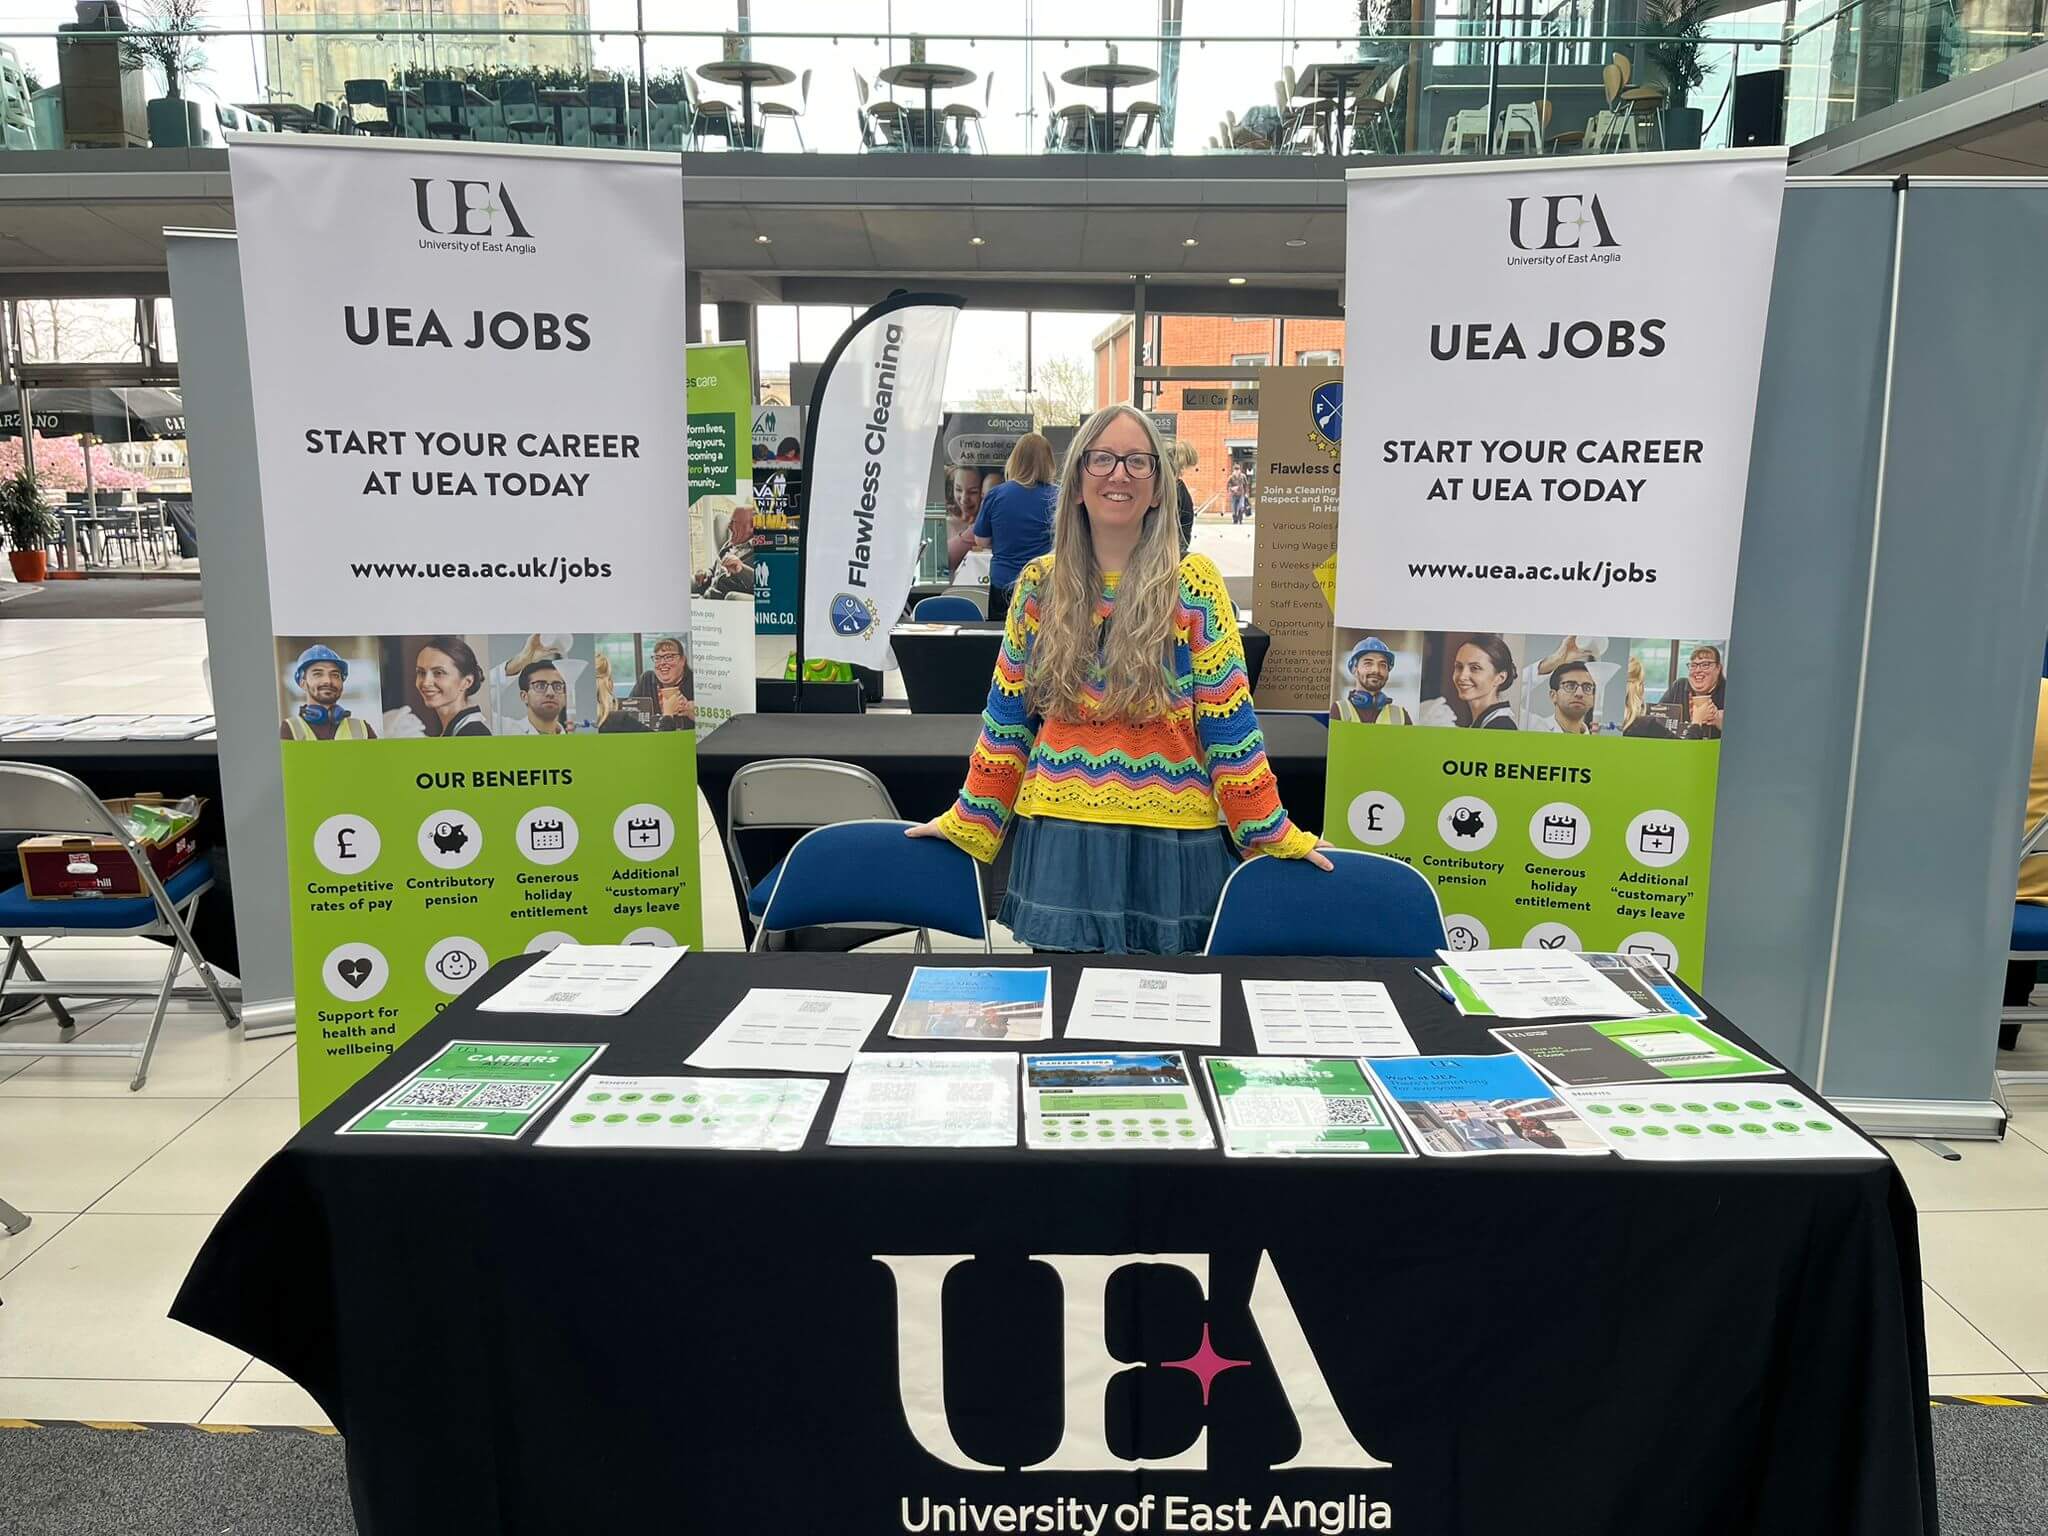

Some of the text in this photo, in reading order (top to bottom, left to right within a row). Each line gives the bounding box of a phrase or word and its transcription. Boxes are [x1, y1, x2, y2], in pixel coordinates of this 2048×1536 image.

[410, 178, 534, 238] UEA
[1506, 193, 1622, 250] UEA
[419, 240, 536, 254] University of East Anglia
[1507, 252, 1621, 266] University of East Anglia
[344, 306, 591, 352] UEA JOBS
[1429, 319, 1666, 361] UEA JOBS
[1232, 394, 1254, 405] Park
[0, 414, 59, 428] RZNO
[687, 424, 705, 433] form
[305, 429, 640, 459] START YOUR CAREER
[1383, 440, 1704, 463] START YOUR CAREER
[687, 451, 717, 461] coming
[848, 323, 903, 588] Flawless Cleaning
[688, 466, 702, 474] ero
[711, 466, 728, 476] your
[1270, 463, 1329, 474] Flawless
[362, 471, 590, 497] AT UEA TODAY
[1264, 486, 1284, 494] Join
[1294, 486, 1336, 496] Cleaning
[1427, 478, 1646, 502] AT UEA TODAY
[1261, 496, 1300, 505] Respect
[1302, 496, 1321, 504] and
[1313, 504, 1322, 512] in
[1273, 522, 1333, 530] Various Roles
[1273, 542, 1329, 551] Living Wage
[351, 557, 612, 584] www.uea.ac.uk/jobs
[1280, 561, 1310, 569] Weeks
[1408, 561, 1657, 588] www.uea.ac.uk/jobs
[1271, 581, 1309, 590] Birthday
[1270, 600, 1323, 608] Staff Events
[1269, 619, 1325, 629] Opportunity
[1268, 628, 1309, 637] Charities
[1299, 648, 1332, 656] interest
[1264, 667, 1291, 675] xplore
[415, 769, 573, 790] OUR BENEFITS
[1442, 760, 1592, 784] OUR BENEFITS
[1422, 855, 1505, 874] Contributory
[1524, 863, 1586, 879] Generous
[516, 871, 579, 885] Generous
[612, 867, 680, 881] Additional
[1437, 872, 1487, 888] pension
[1618, 871, 1689, 887] Additional
[307, 879, 394, 897] Competitive
[406, 874, 495, 892] Contributory
[1530, 879, 1578, 896] holiday
[425, 893, 478, 909] pension
[524, 886, 573, 903] holiday
[310, 898, 393, 913] rates of pay
[510, 904, 588, 919] entitlement
[613, 900, 681, 917] days leave
[1515, 895, 1592, 912] entitlement
[1616, 904, 1686, 920] days leave
[318, 1006, 399, 1025] Support for
[322, 1023, 396, 1040] health and
[327, 1040, 394, 1056] wellbeing
[467, 1054, 560, 1063] CAREERS
[872, 1248, 1393, 1472] UEA
[901, 1494, 1392, 1536] University of East Anglia
